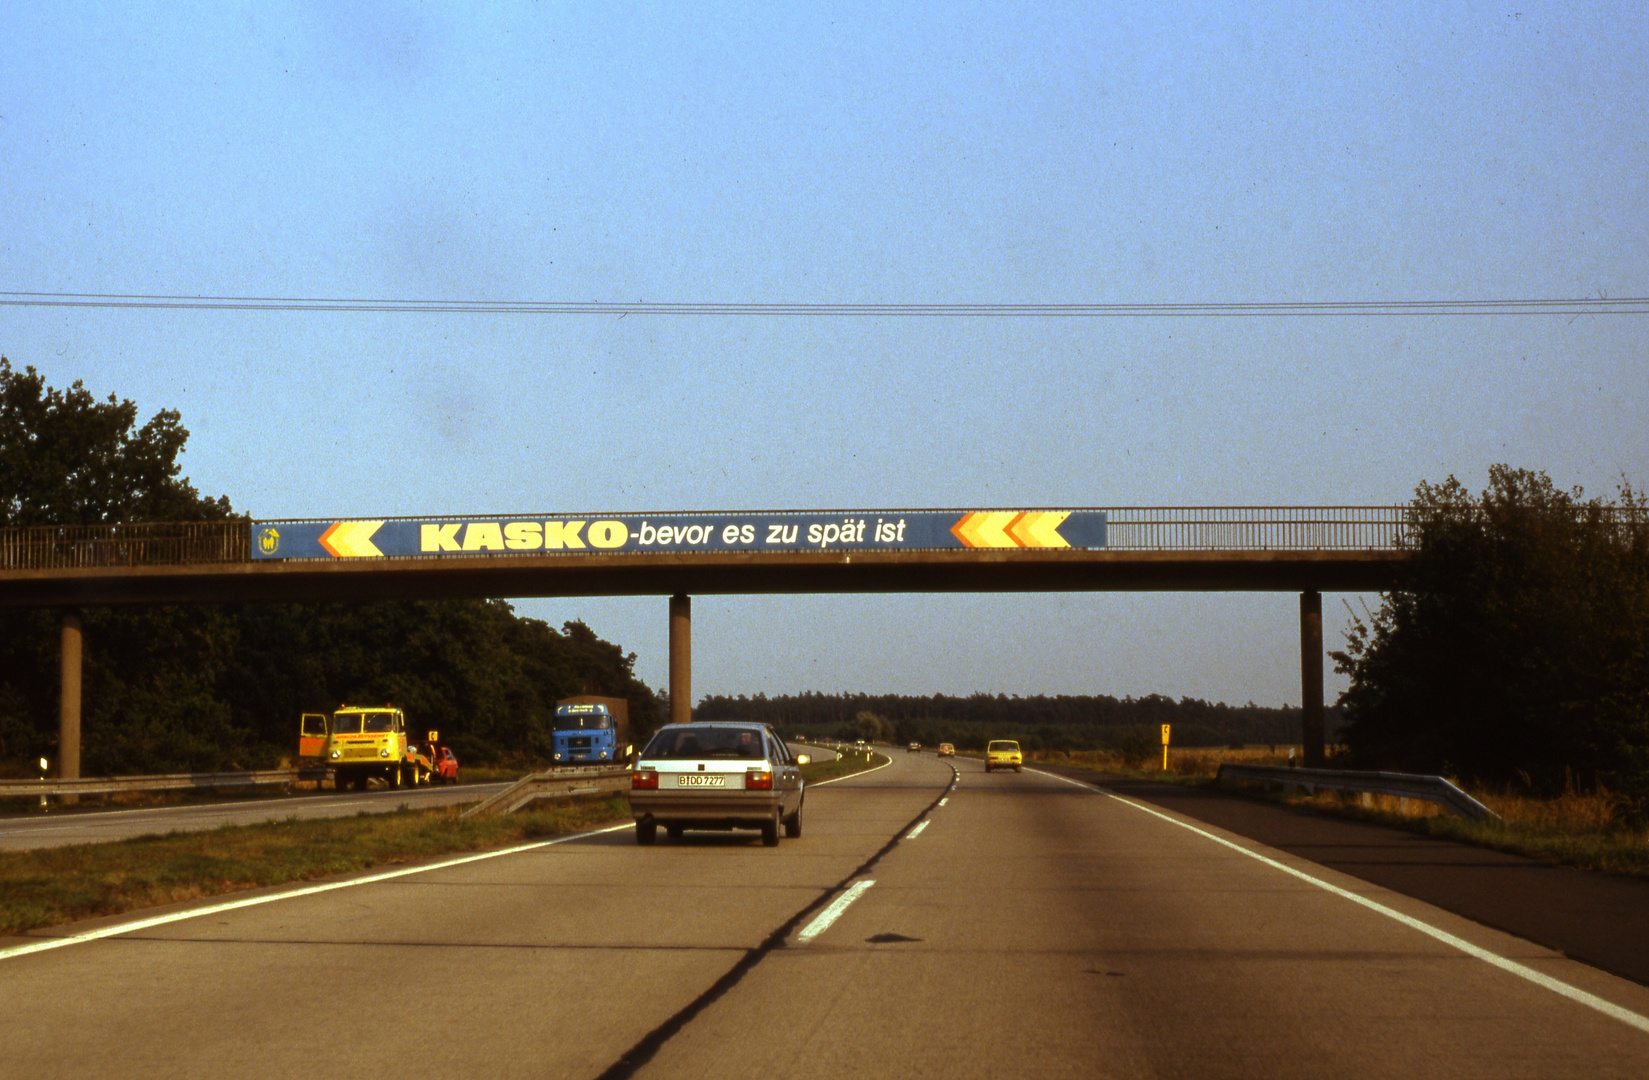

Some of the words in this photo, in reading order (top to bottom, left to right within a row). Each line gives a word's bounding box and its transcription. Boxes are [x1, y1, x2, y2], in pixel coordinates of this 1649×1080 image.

[721, 524, 756, 545] es
[765, 525, 799, 545] zu
[806, 519, 867, 550] spät
[873, 518, 907, 543] ist
[704, 776, 724, 785] 7277
